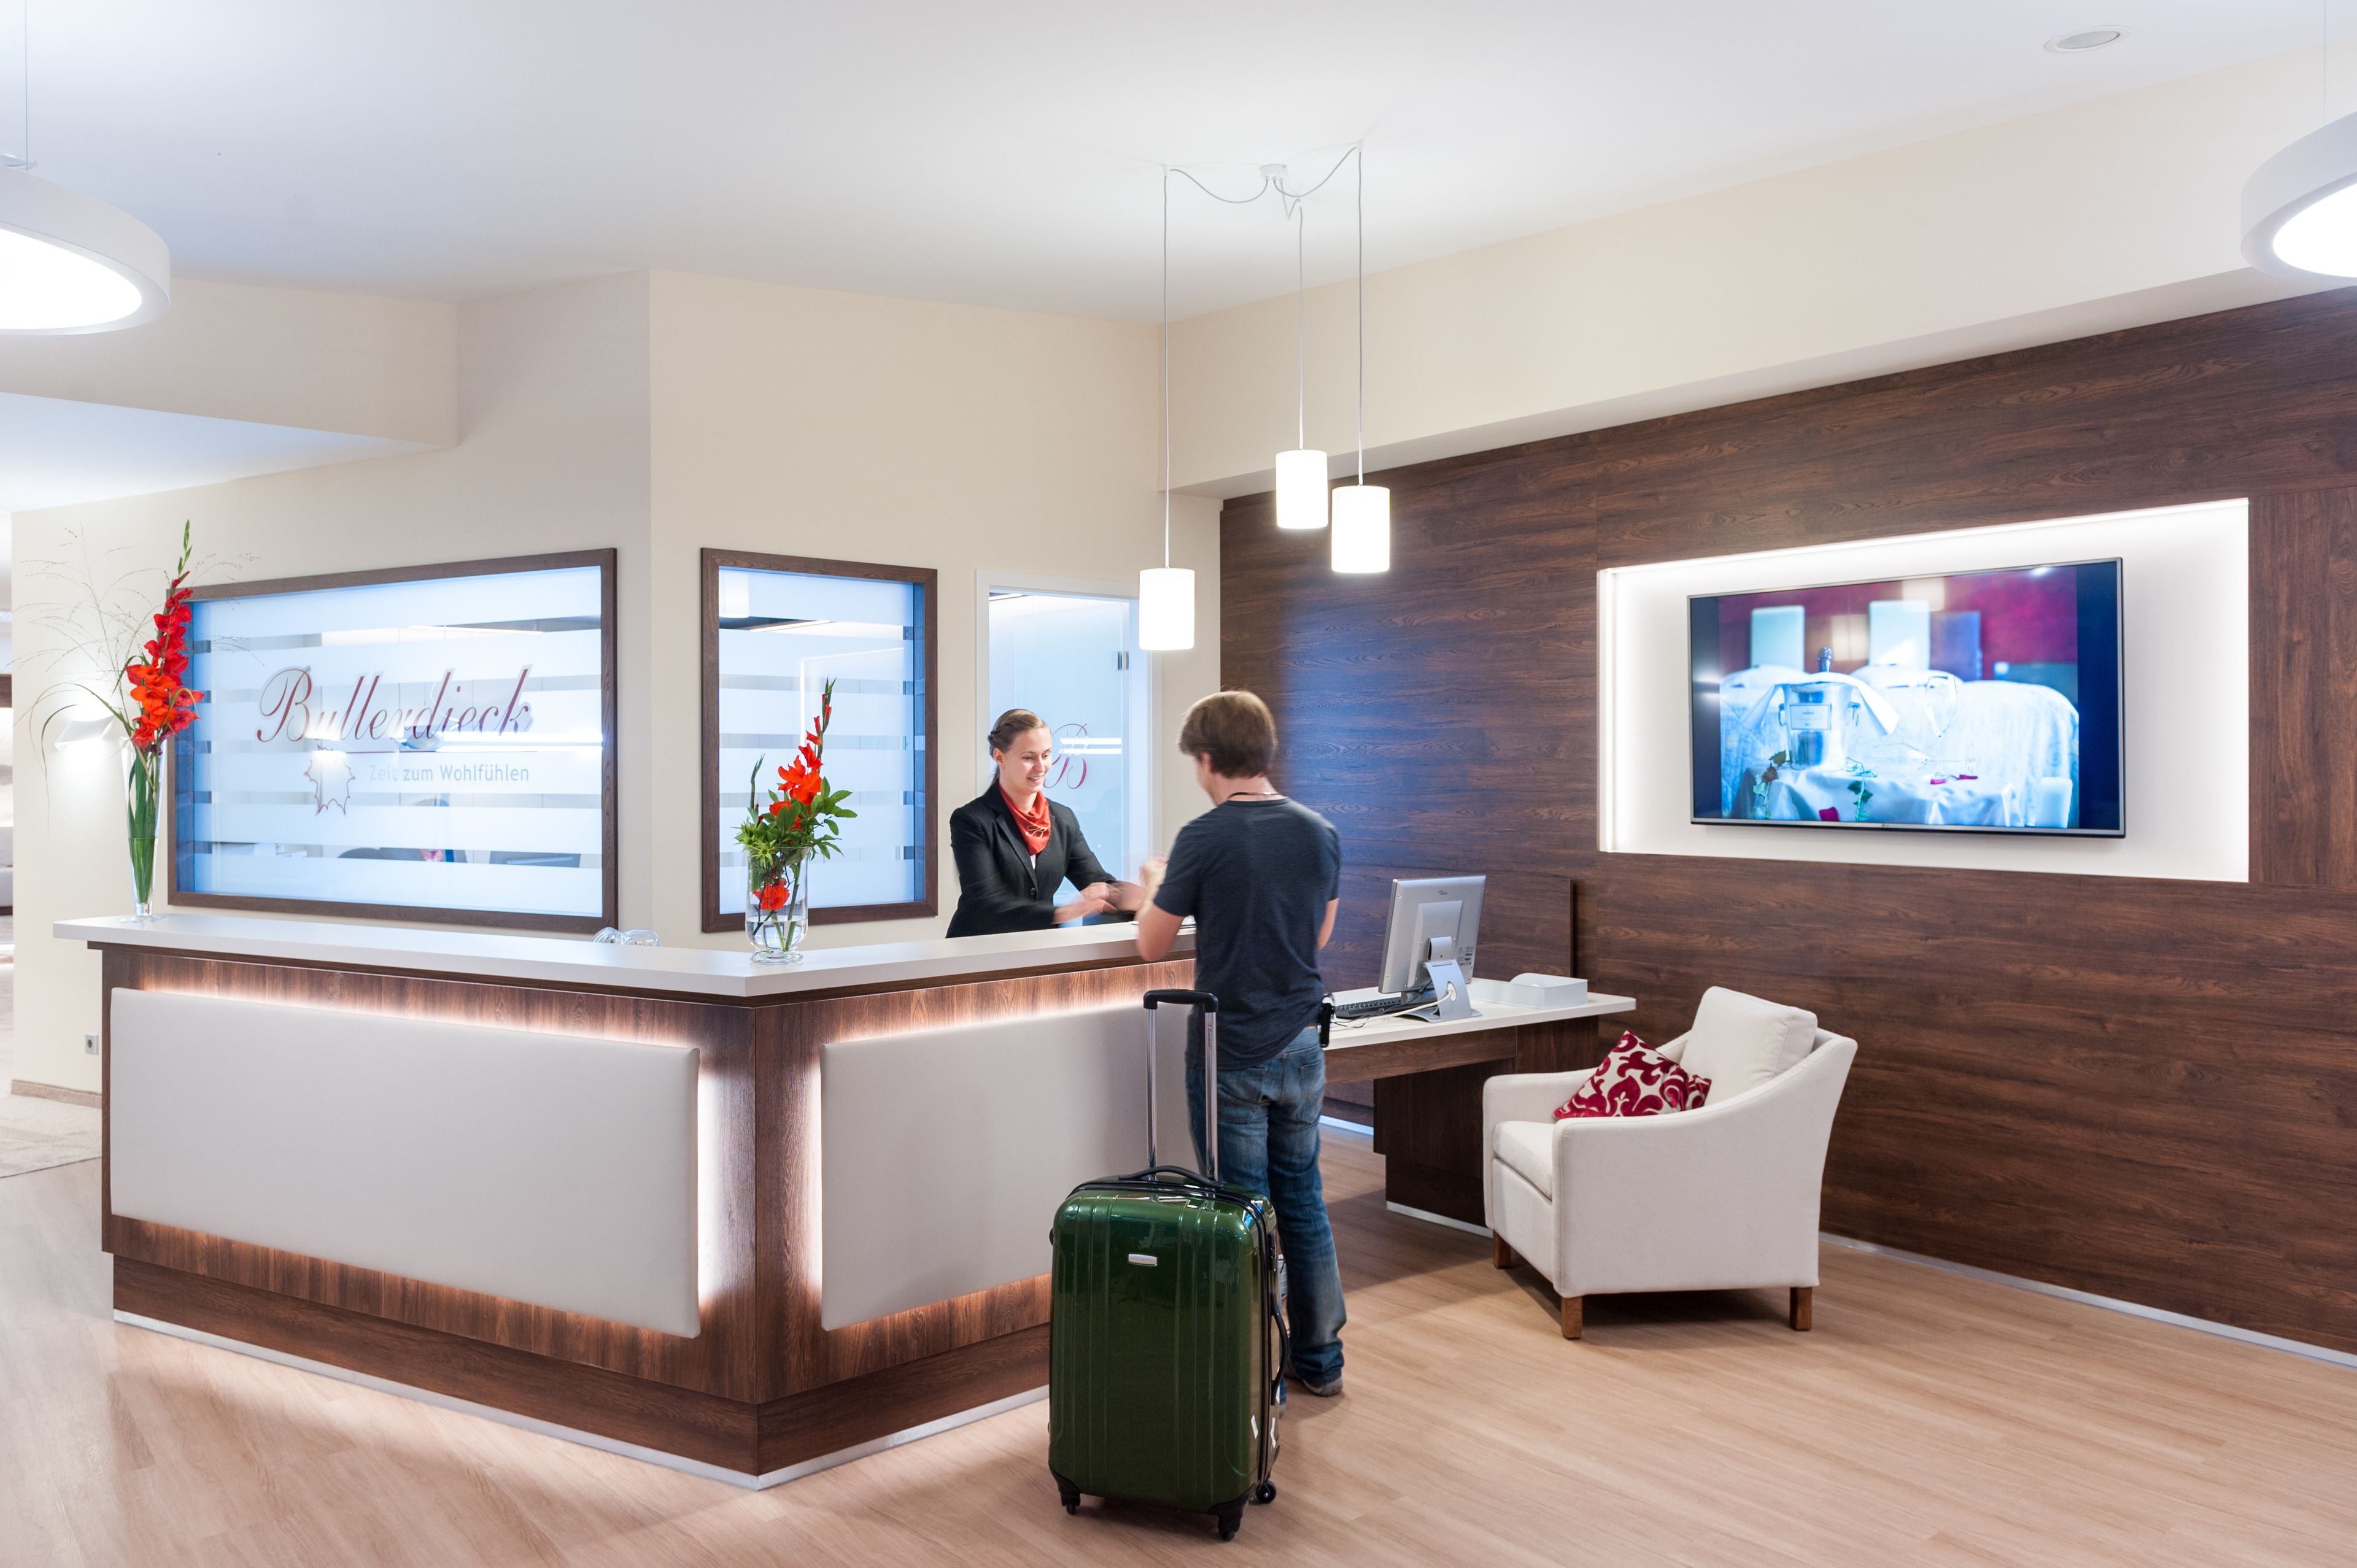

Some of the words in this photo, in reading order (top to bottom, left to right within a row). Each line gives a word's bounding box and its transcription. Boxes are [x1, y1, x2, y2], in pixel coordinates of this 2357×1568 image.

[257, 665, 534, 743] Bullerdieck
[369, 764, 398, 781] Zeit
[403, 768, 433, 781] zum
[439, 763, 530, 781] Wohlfühlen
